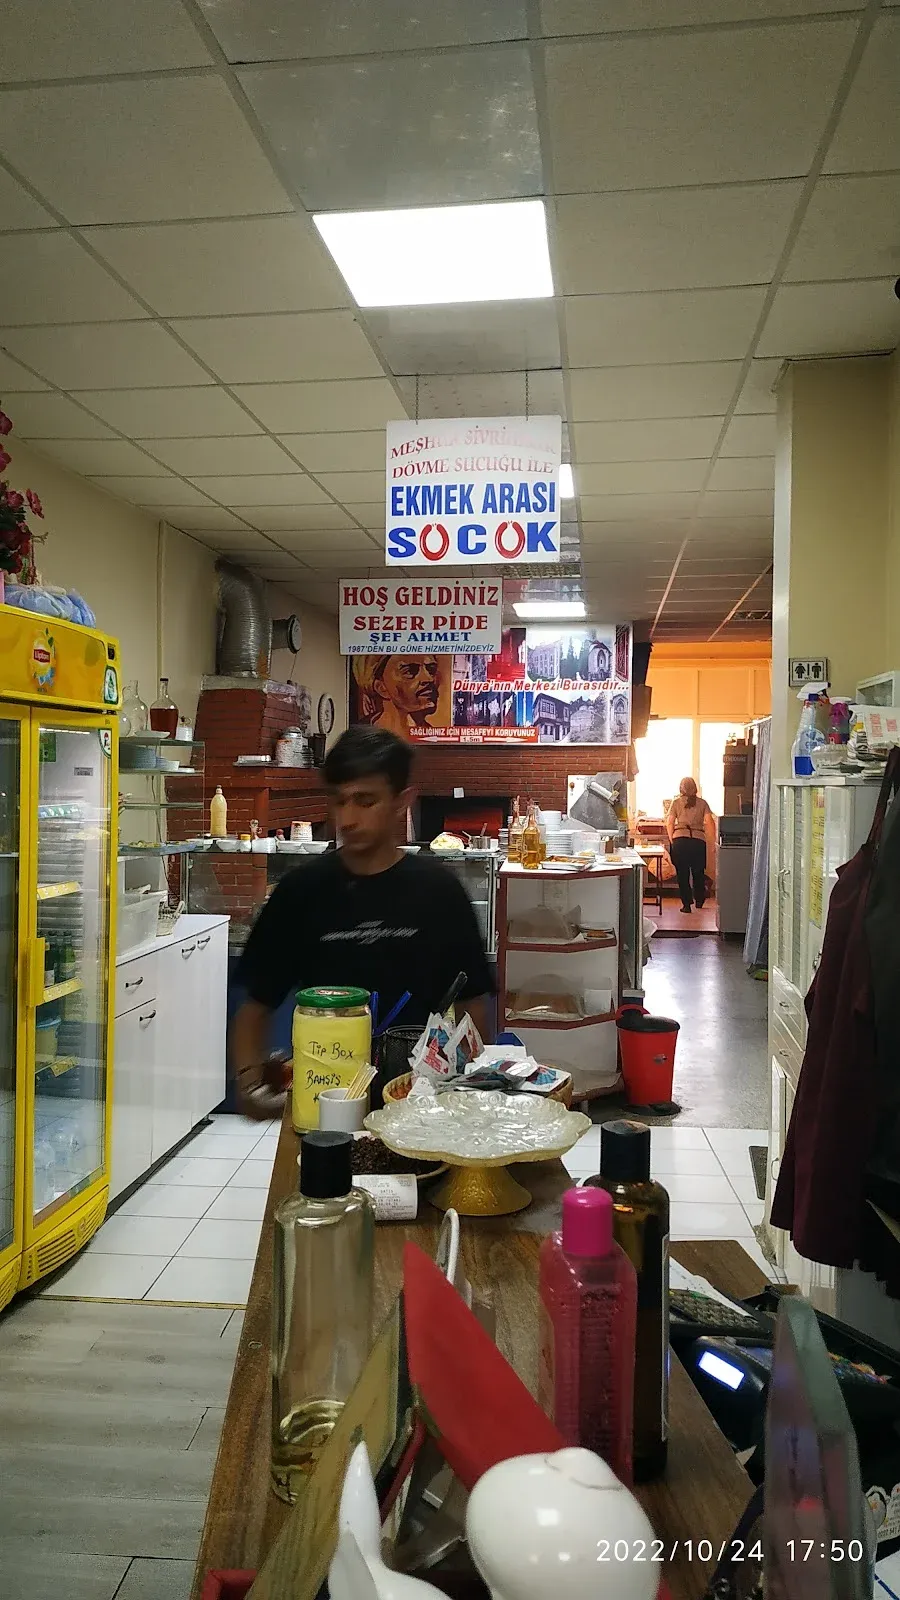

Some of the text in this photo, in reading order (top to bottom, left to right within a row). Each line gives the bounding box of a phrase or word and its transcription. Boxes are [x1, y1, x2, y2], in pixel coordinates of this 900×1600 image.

[392, 454, 554, 479] DÖVME SUCUĞU İLE
[391, 482, 556, 516] EKMEK ARASI
[343, 580, 499, 612] HOŞ GELDİNİZ
[353, 611, 488, 631] SEZER PİDE
[369, 632, 472, 645] ŞEF AHMET
[348, 645, 384, 653] 1987'DEN
[400, 645, 423, 653] GÜNE
[453, 680, 511, 695] Dünya'nın
[514, 680, 560, 691] Merkezi
[410, 727, 536, 737] SAĞLIĞINIZ İÇİN MESAFEYİ KORUYUNUZ
[330, 1042, 354, 1060] Box
